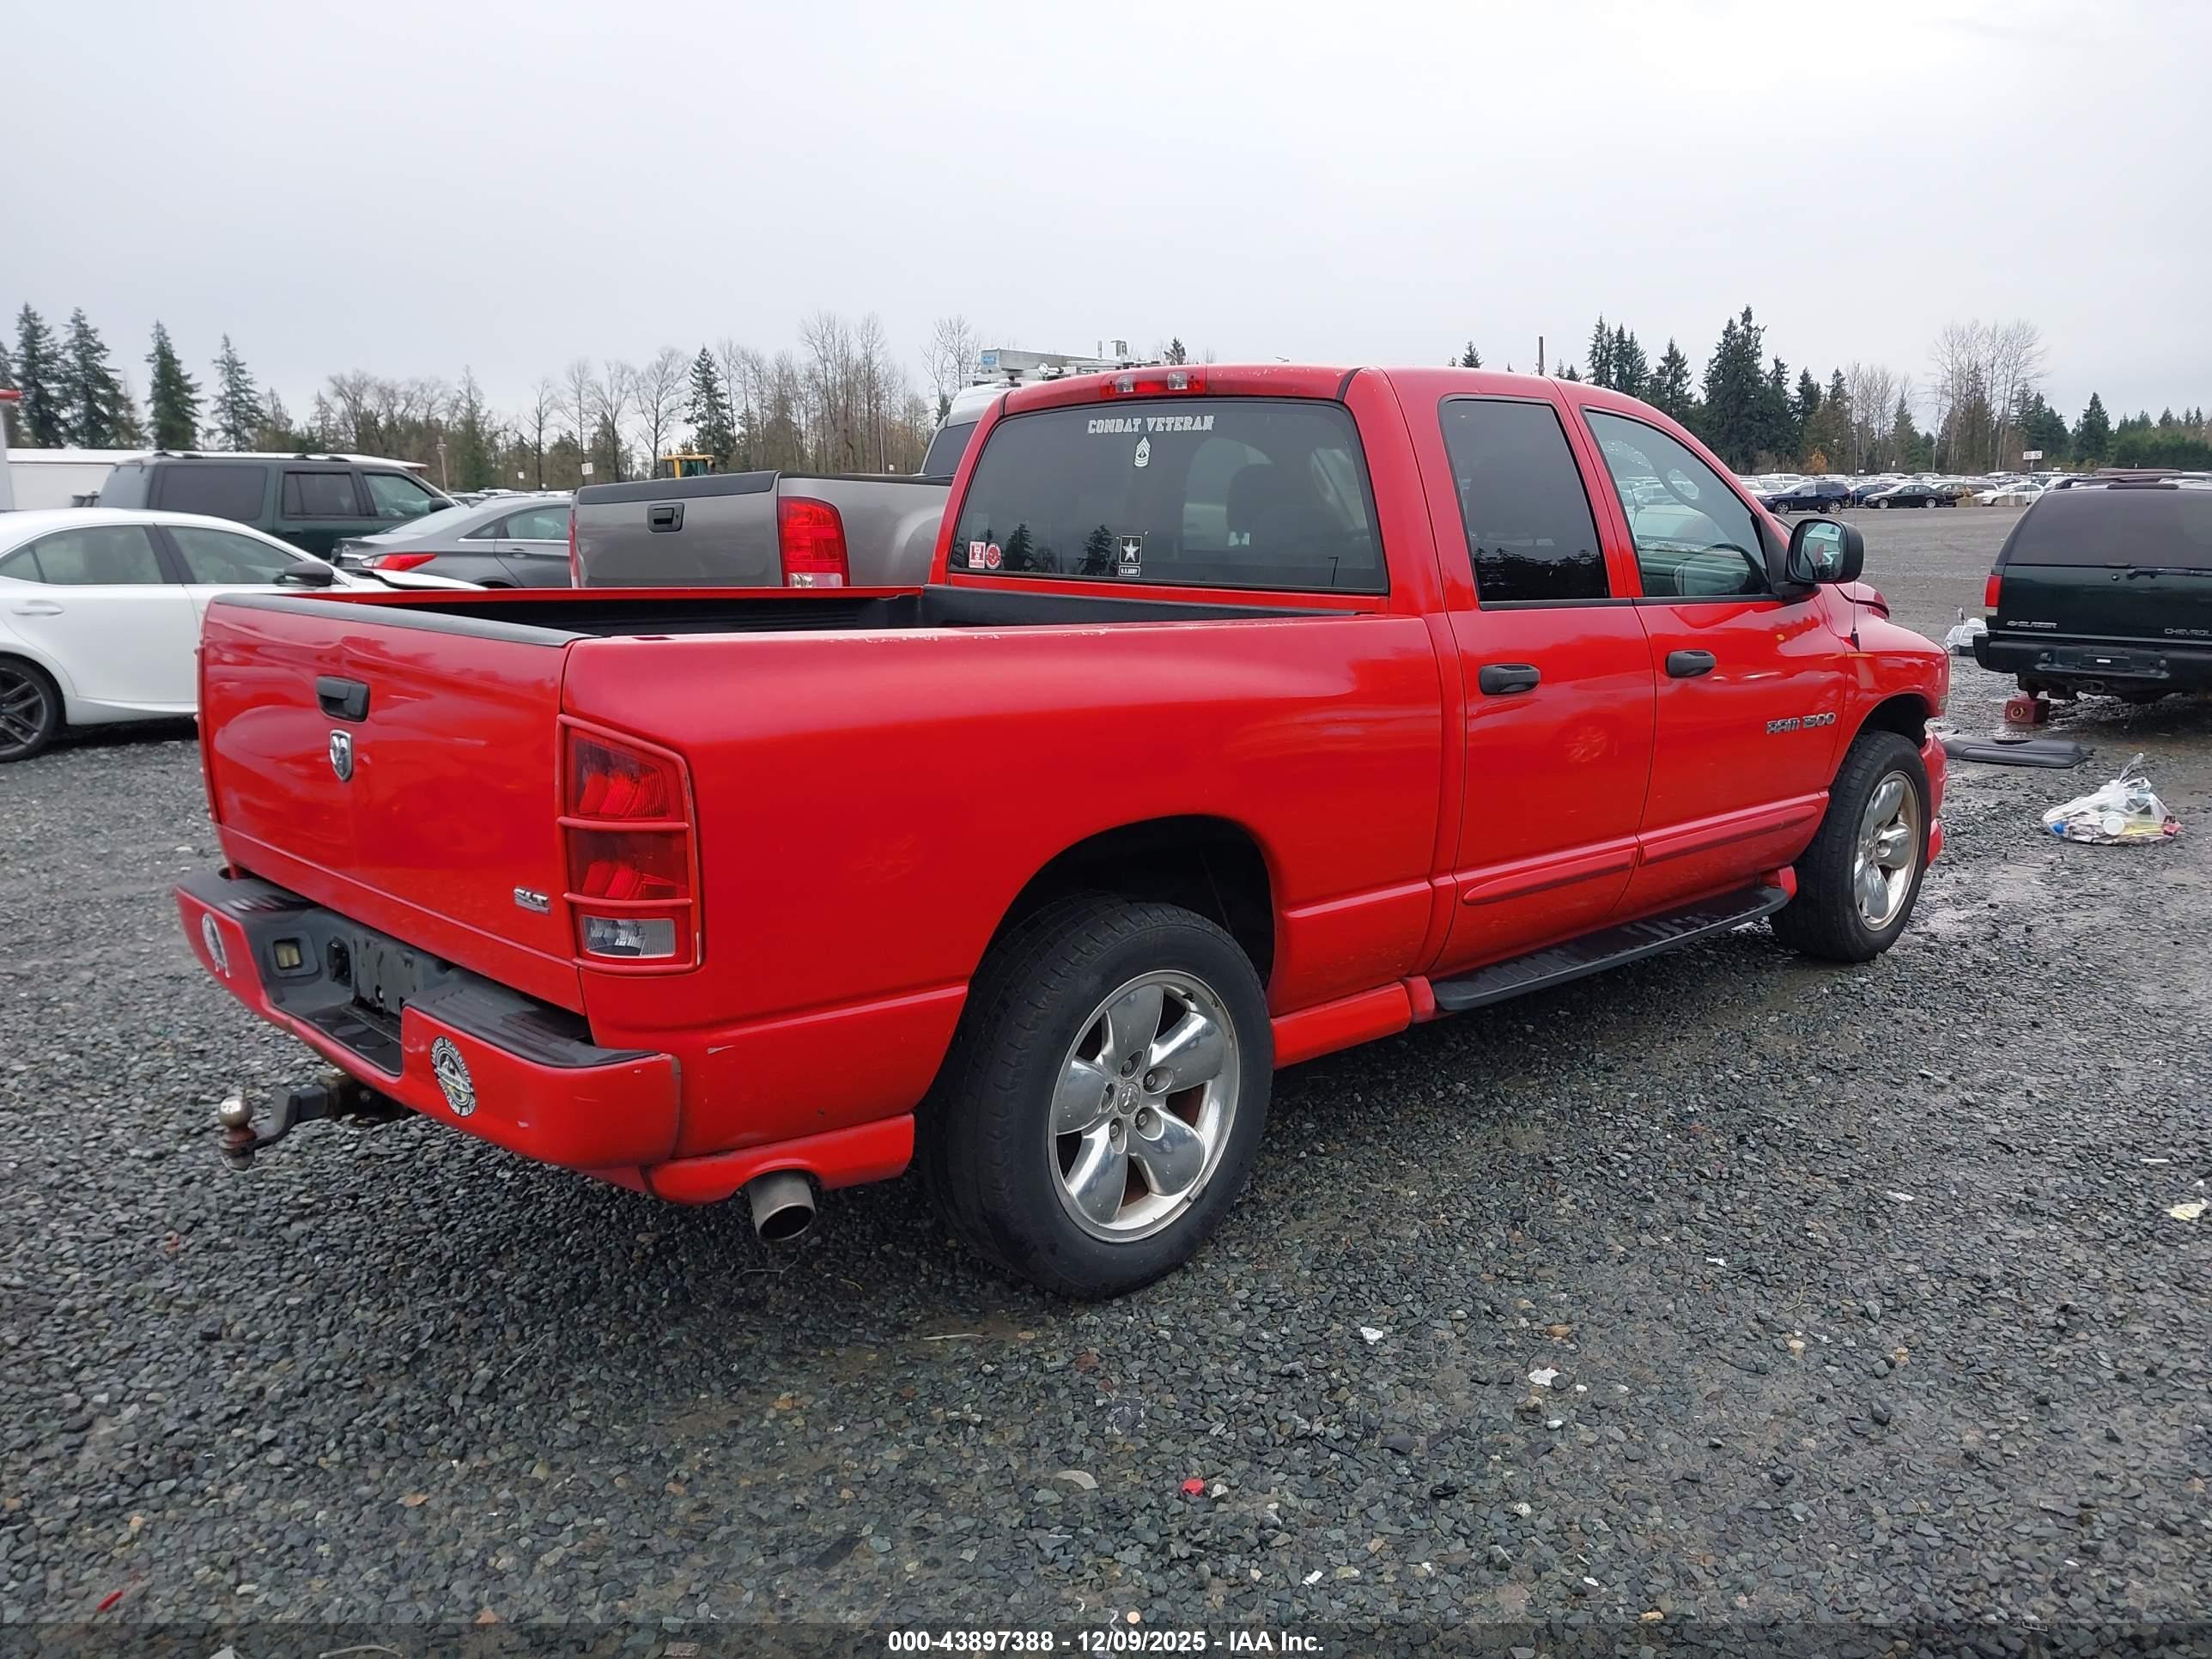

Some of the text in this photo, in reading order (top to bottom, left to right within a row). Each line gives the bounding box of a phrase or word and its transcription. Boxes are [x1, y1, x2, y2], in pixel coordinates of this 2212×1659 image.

[1087, 416, 1214, 434] COMBAT VETERAN
[1766, 712, 1836, 734] RAM 1500
[514, 887, 550, 906] SLT
